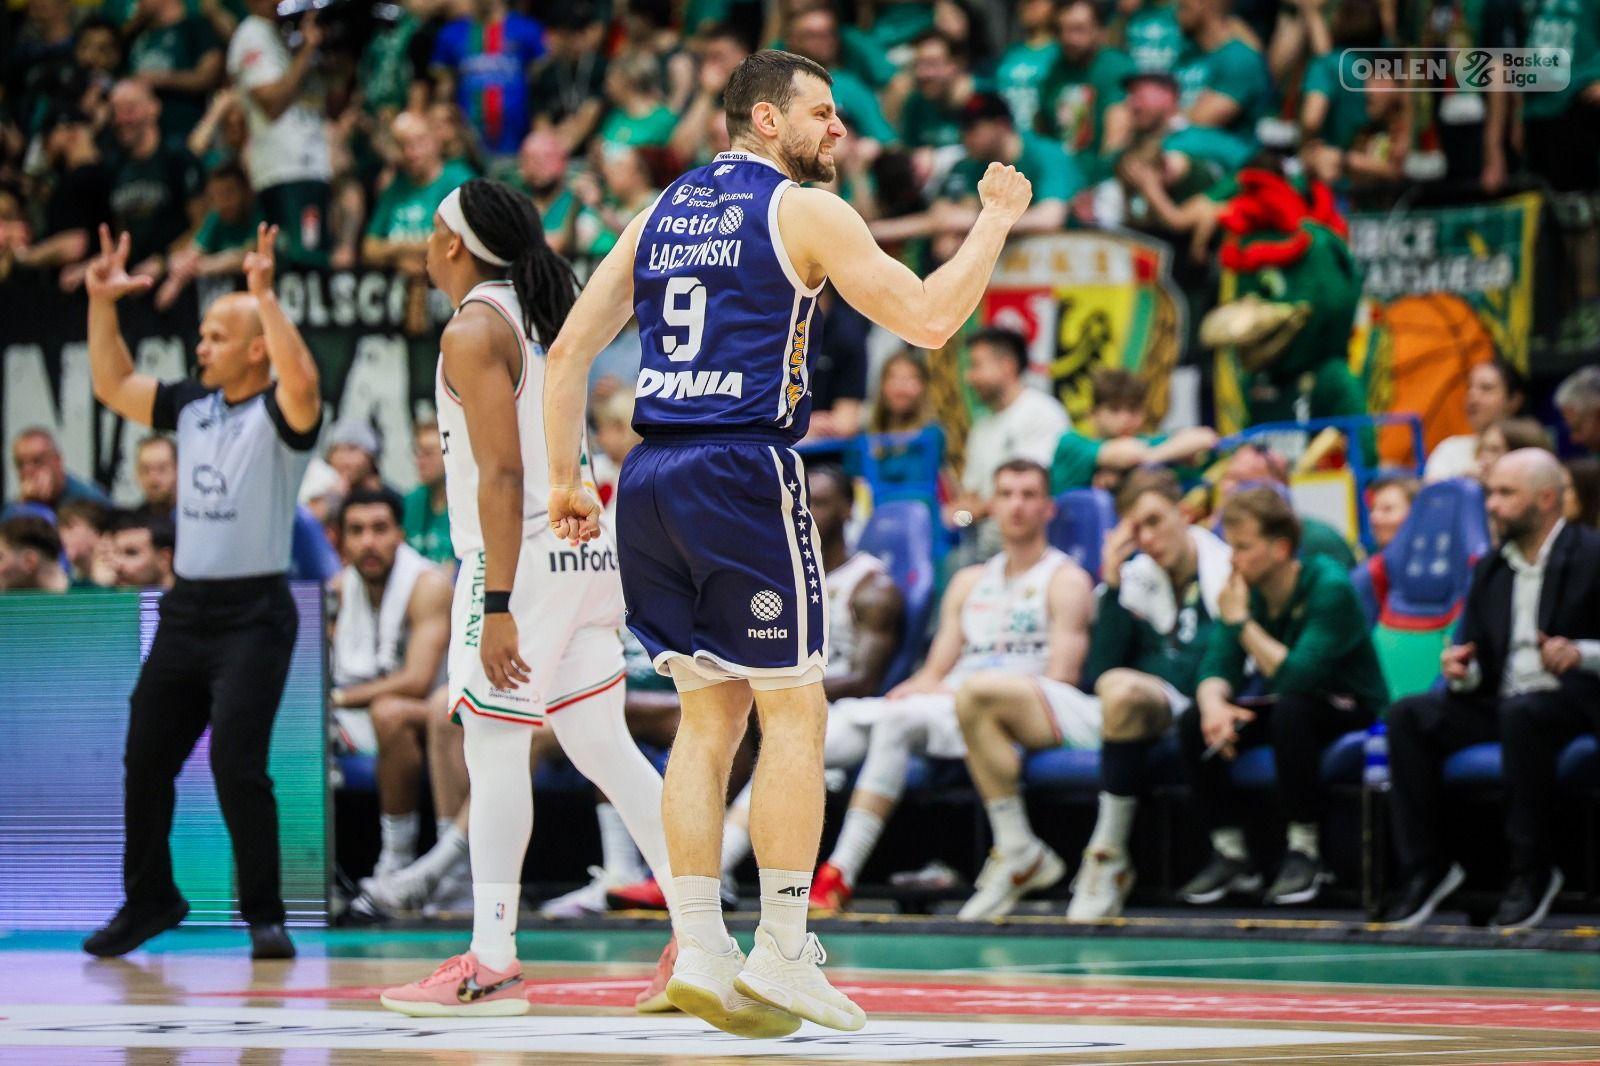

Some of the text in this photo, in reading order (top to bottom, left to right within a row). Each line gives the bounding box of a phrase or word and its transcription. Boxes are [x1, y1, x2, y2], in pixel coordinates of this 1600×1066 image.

[693, 187, 715, 197] PGZ
[656, 213, 720, 236] netia
[648, 236, 742, 273] ŁĄCZYŃSKI
[662, 276, 707, 362] 9
[549, 543, 619, 572] infort
[747, 626, 788, 640] netia
